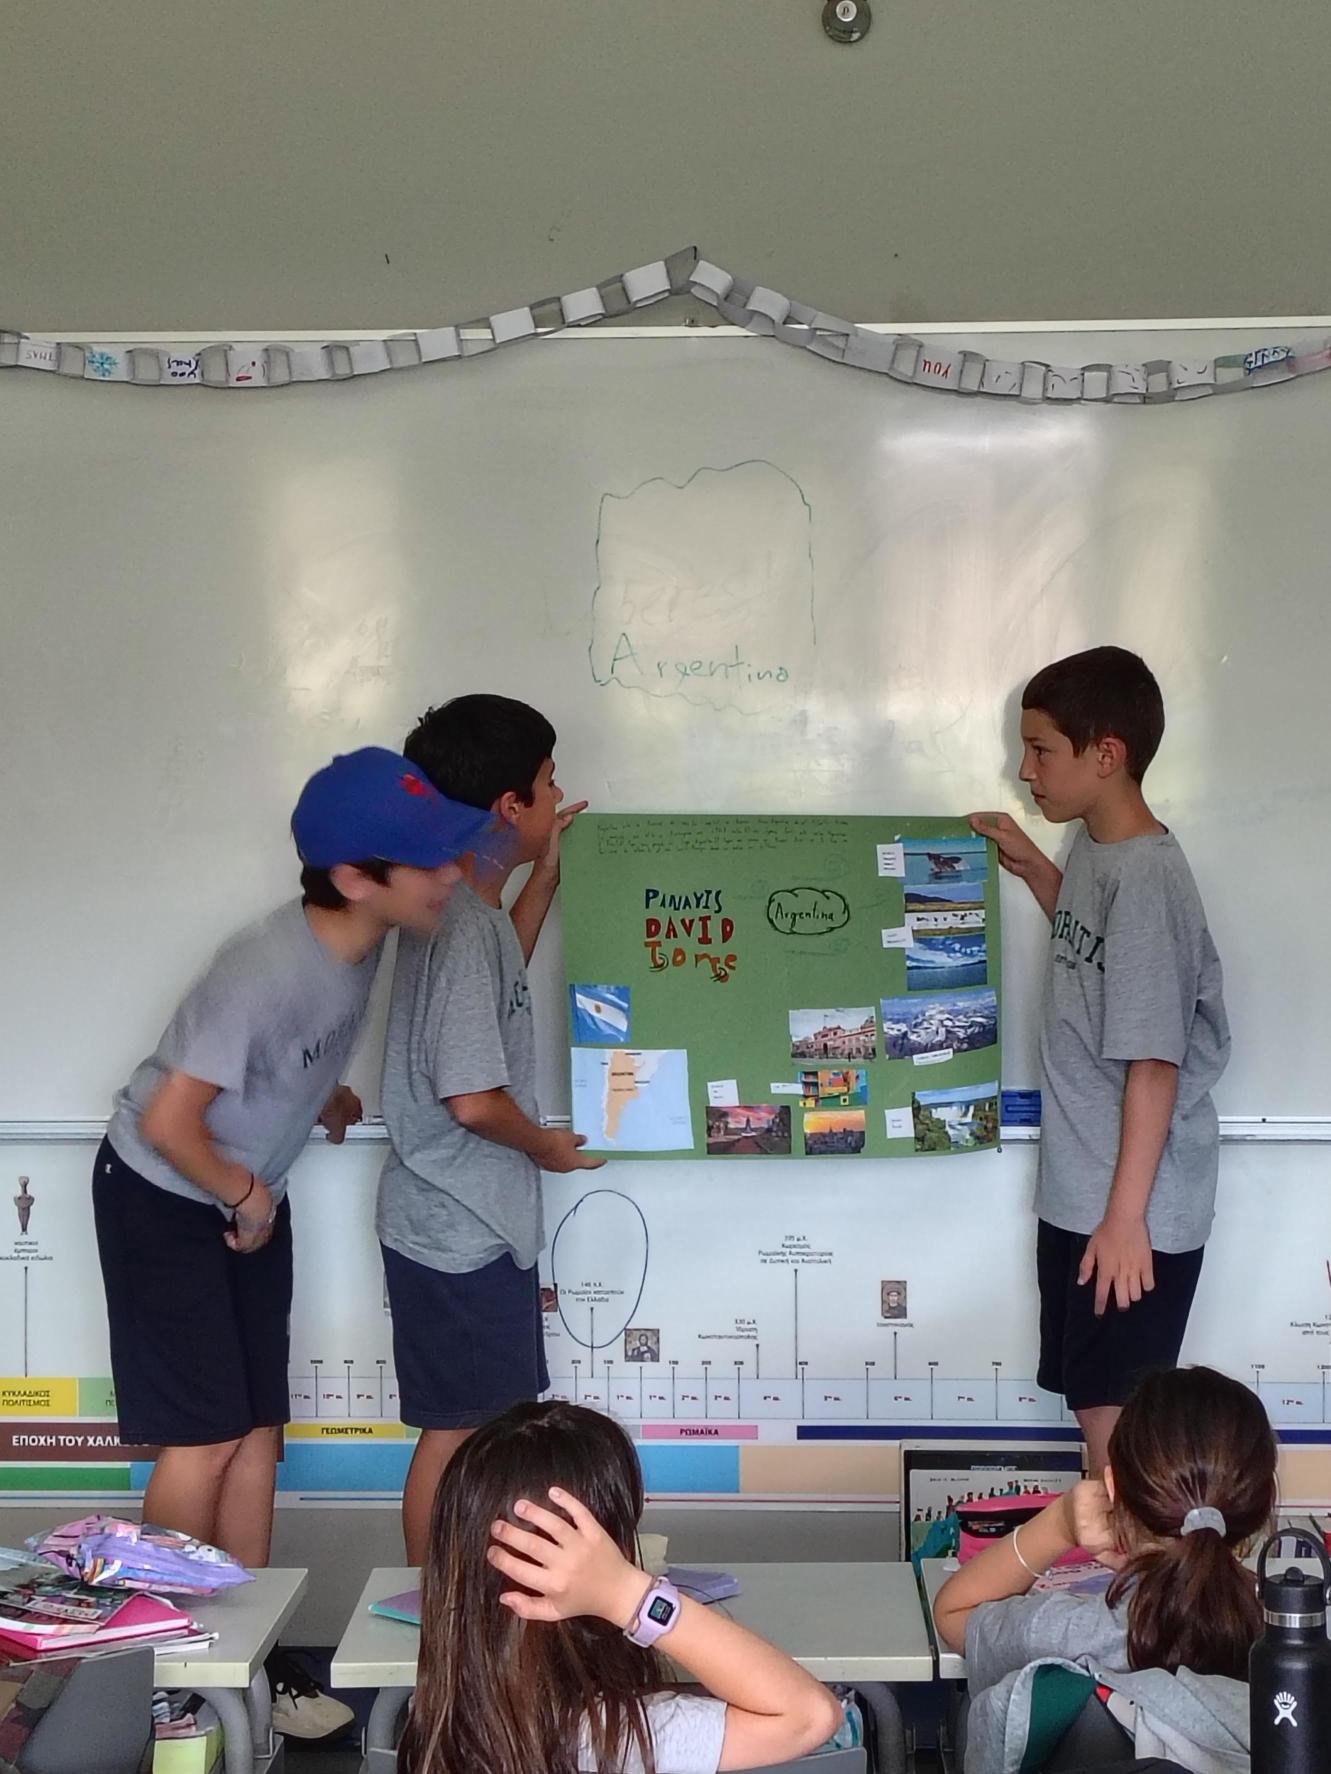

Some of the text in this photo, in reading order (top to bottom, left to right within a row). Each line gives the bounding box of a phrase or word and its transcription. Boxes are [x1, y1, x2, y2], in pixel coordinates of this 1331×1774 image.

[645, 889, 722, 914] PANAYIS
[645, 915, 734, 944] DAVID
[1, 1399, 51, 1407] ΠΟΛΙΤΙΣΜΟΣ
[321, 1426, 373, 1435] ΓΕΩΜΕΤΡΙΚΑ
[680, 1427, 719, 1436] ΡΩΜΑΪΚΑ
[12, 1434, 56, 1447] ΕΠΟΧΗ
[58, 1434, 84, 1447] ΤΟΥ
